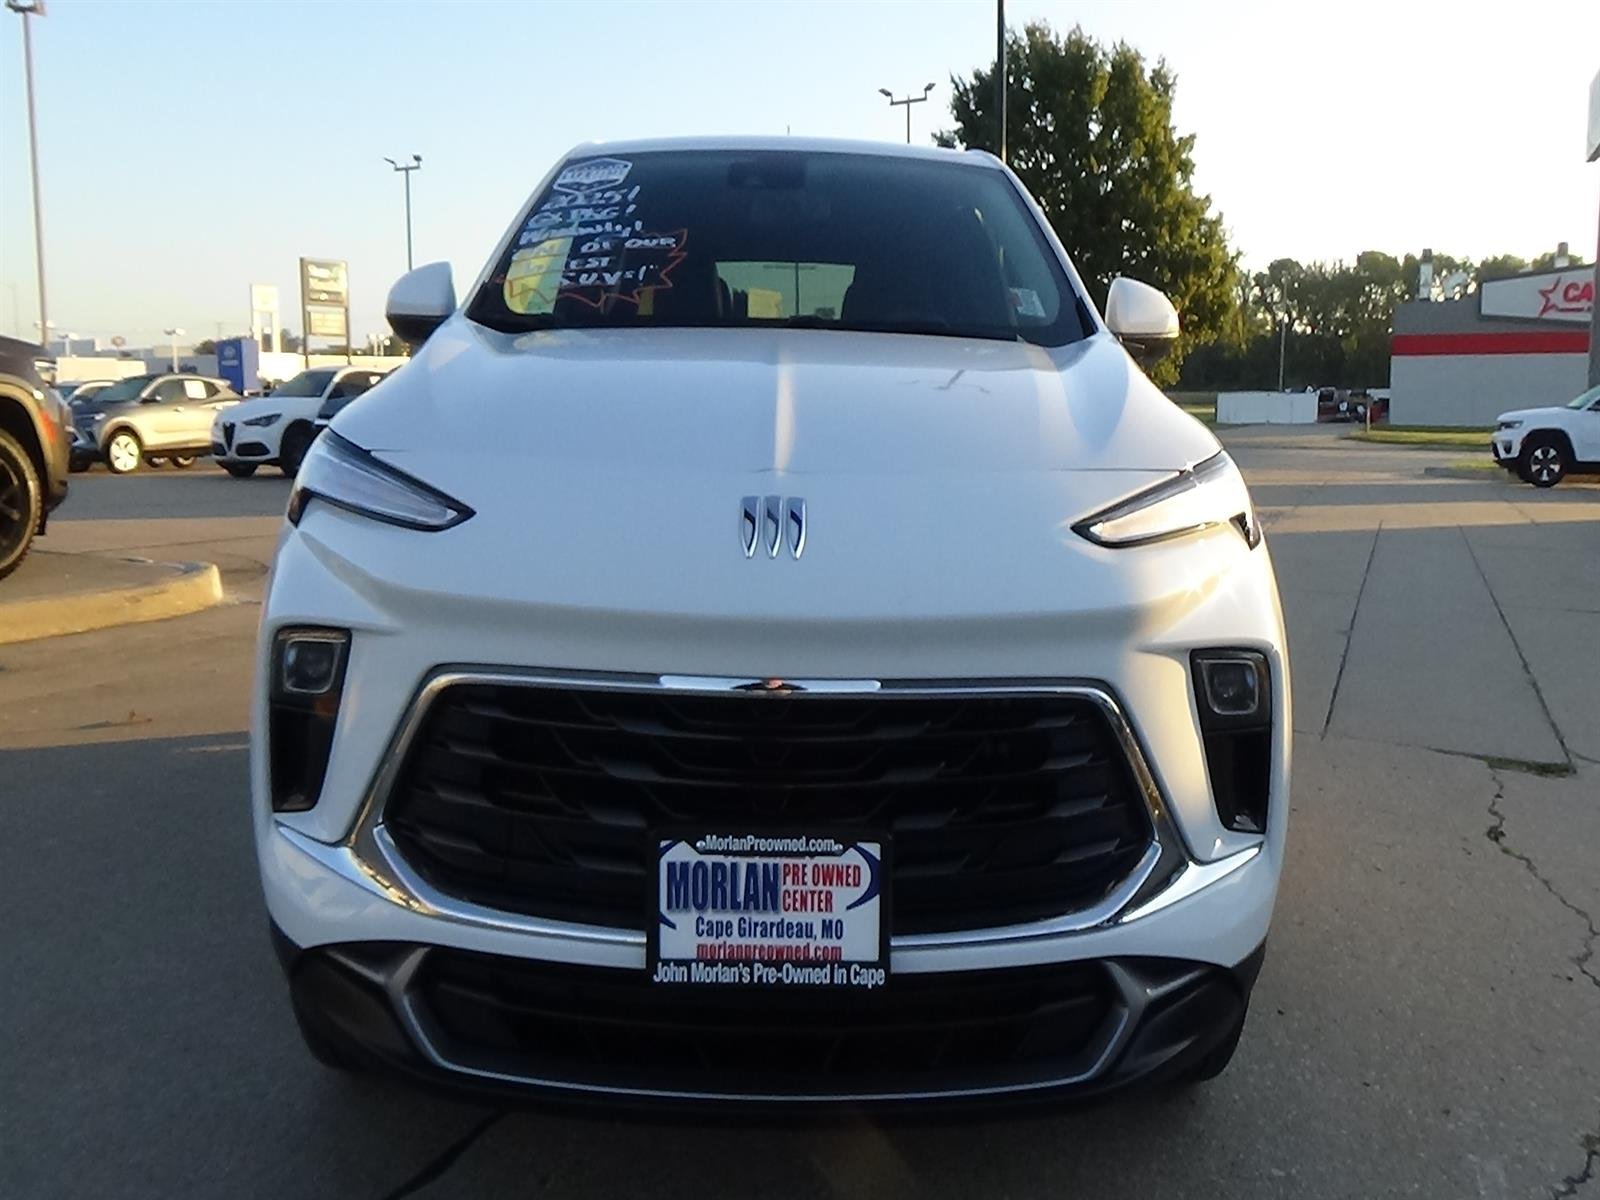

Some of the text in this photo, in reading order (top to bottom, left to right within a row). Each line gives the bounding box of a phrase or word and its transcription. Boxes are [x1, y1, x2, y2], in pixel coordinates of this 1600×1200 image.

[705, 835, 835, 853] MorlanPreowned.com
[666, 861, 780, 912] MORLAN
[782, 863, 861, 888] PRE OWNED
[782, 890, 833, 913] CENTER
[695, 917, 844, 941] Cape Girardeau, MO
[696, 941, 842, 960] morlanpreowned.com
[653, 962, 688, 983] John
[691, 962, 751, 984] Morlan's
[753, 964, 831, 985] Pre-Owned
[850, 965, 886, 989] Cape
